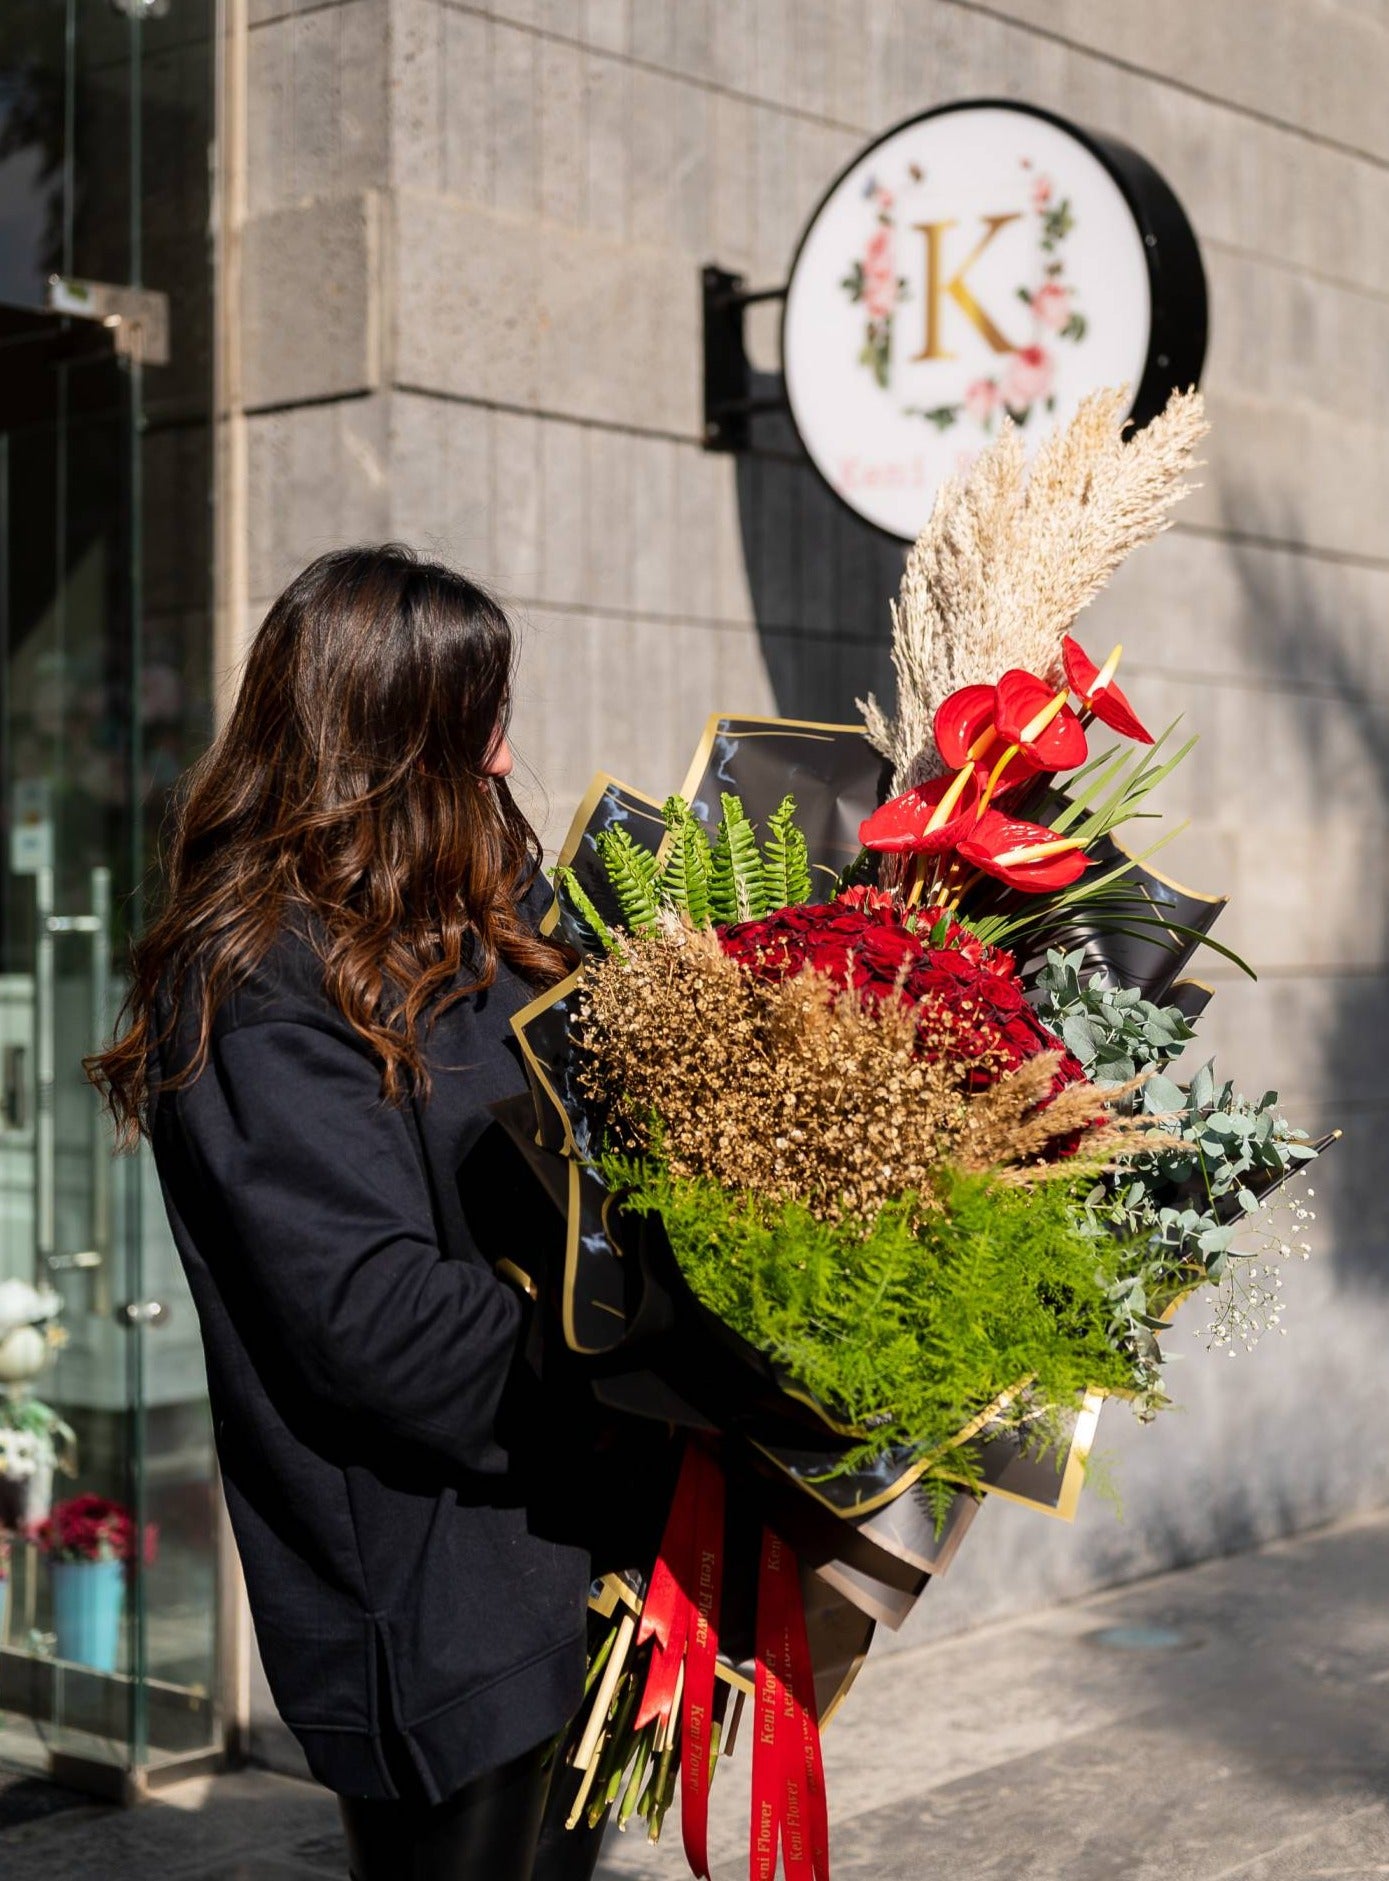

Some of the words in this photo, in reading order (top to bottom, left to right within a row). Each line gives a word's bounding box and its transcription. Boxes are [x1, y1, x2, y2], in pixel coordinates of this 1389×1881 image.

[912, 213, 1023, 362] K
[700, 1551, 715, 1589] Keni
[696, 1590, 714, 1648] Flower
[762, 1650, 777, 1705] Flower
[690, 1704, 705, 1742] Keni
[760, 1708, 776, 1746] Keni
[688, 1743, 703, 1794] Flower
[757, 1800, 773, 1852] Flower
[786, 1779, 801, 1826] Flower
[757, 1855, 771, 1880] eni
[786, 1830, 803, 1861] Keni
